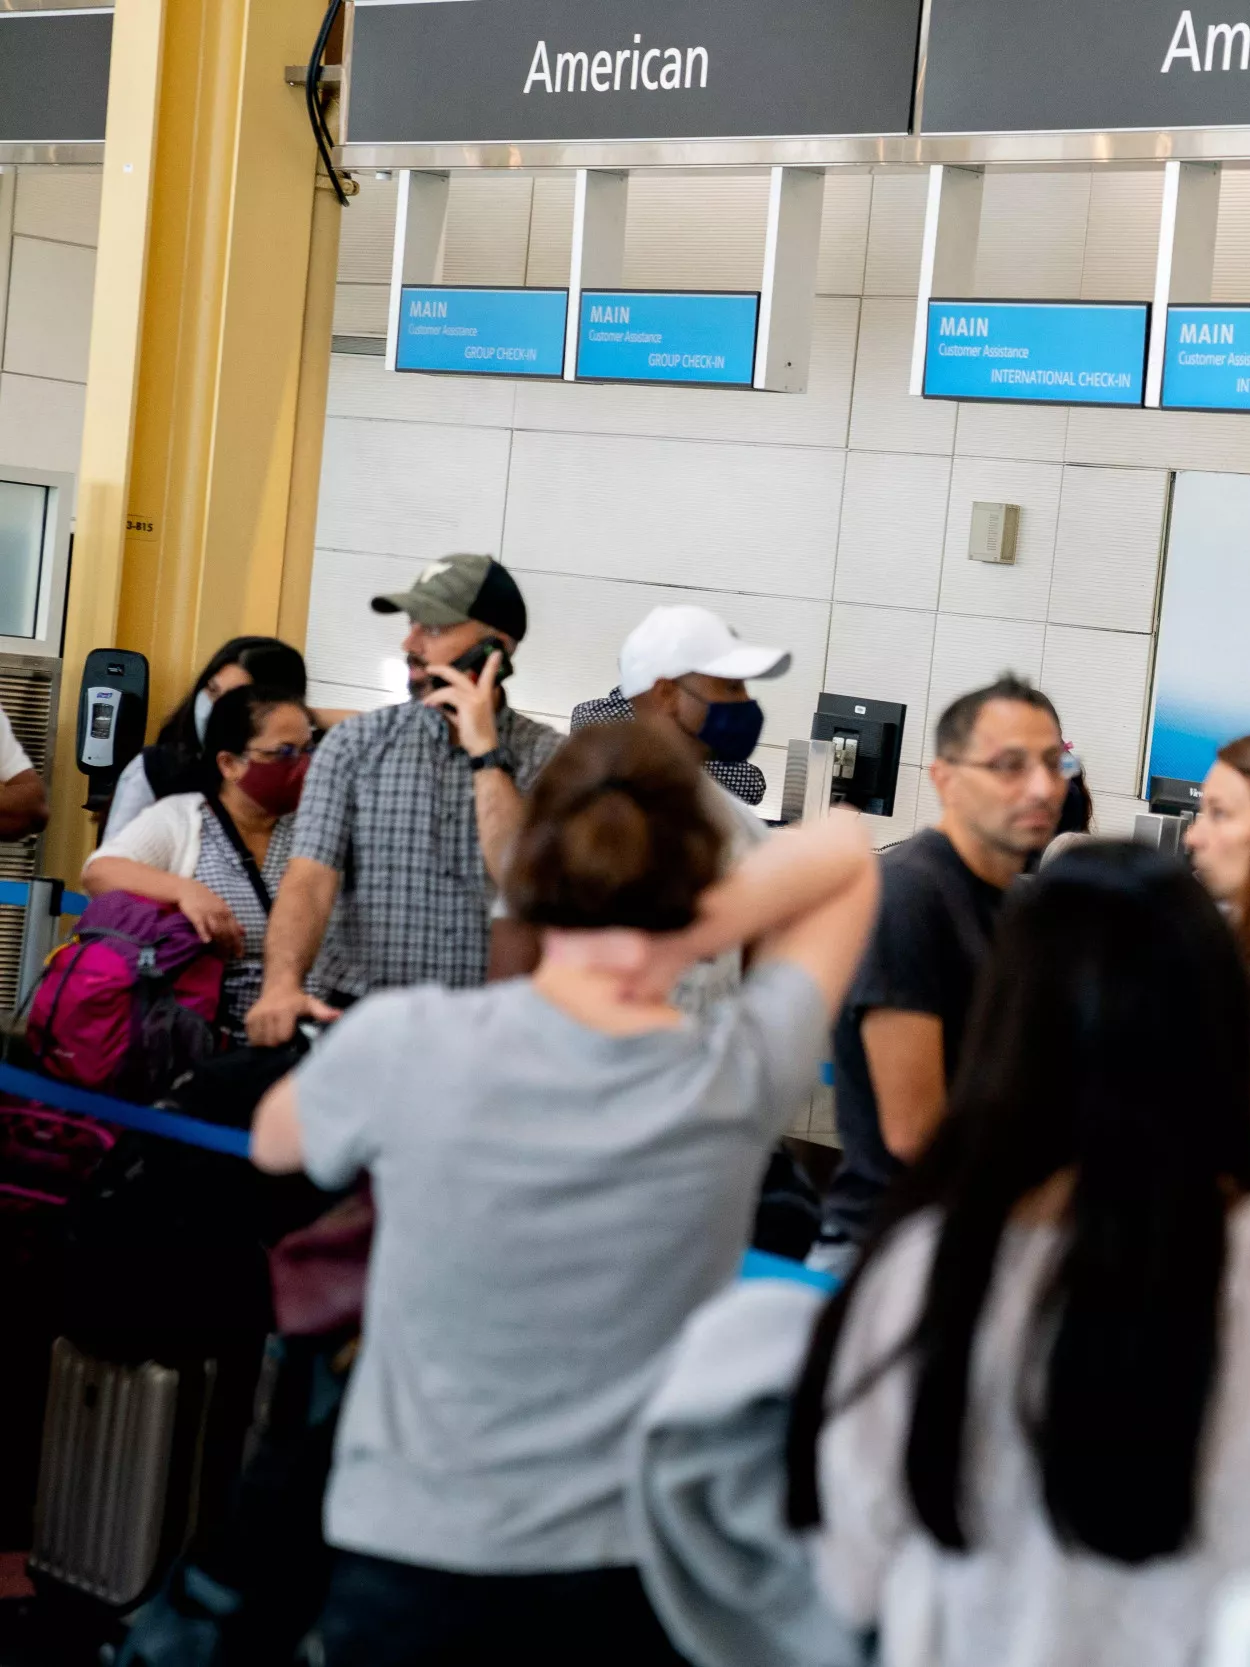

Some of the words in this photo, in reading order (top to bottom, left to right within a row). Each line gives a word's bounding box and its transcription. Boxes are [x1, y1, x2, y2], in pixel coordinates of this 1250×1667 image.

[523, 33, 709, 94] American
[409, 301, 448, 318] MAIN
[590, 305, 630, 324] MAIN
[408, 323, 442, 336] Customer
[442, 325, 478, 337] Assistance
[939, 317, 989, 337] MAIN
[1179, 323, 1234, 345] MAIN
[588, 329, 624, 342] Customer
[624, 330, 662, 343] Assistance
[464, 346, 496, 360] GROUP
[496, 347, 537, 361] CHECK-IN
[938, 343, 982, 357] Customer
[982, 345, 1030, 359] Assistance
[1178, 351, 1226, 366] Customer
[648, 353, 679, 368] GROUP
[681, 354, 725, 369] CHECK-IN
[991, 369, 1075, 386] INTERNATIONAL
[1077, 371, 1131, 388] CHECK-IN
